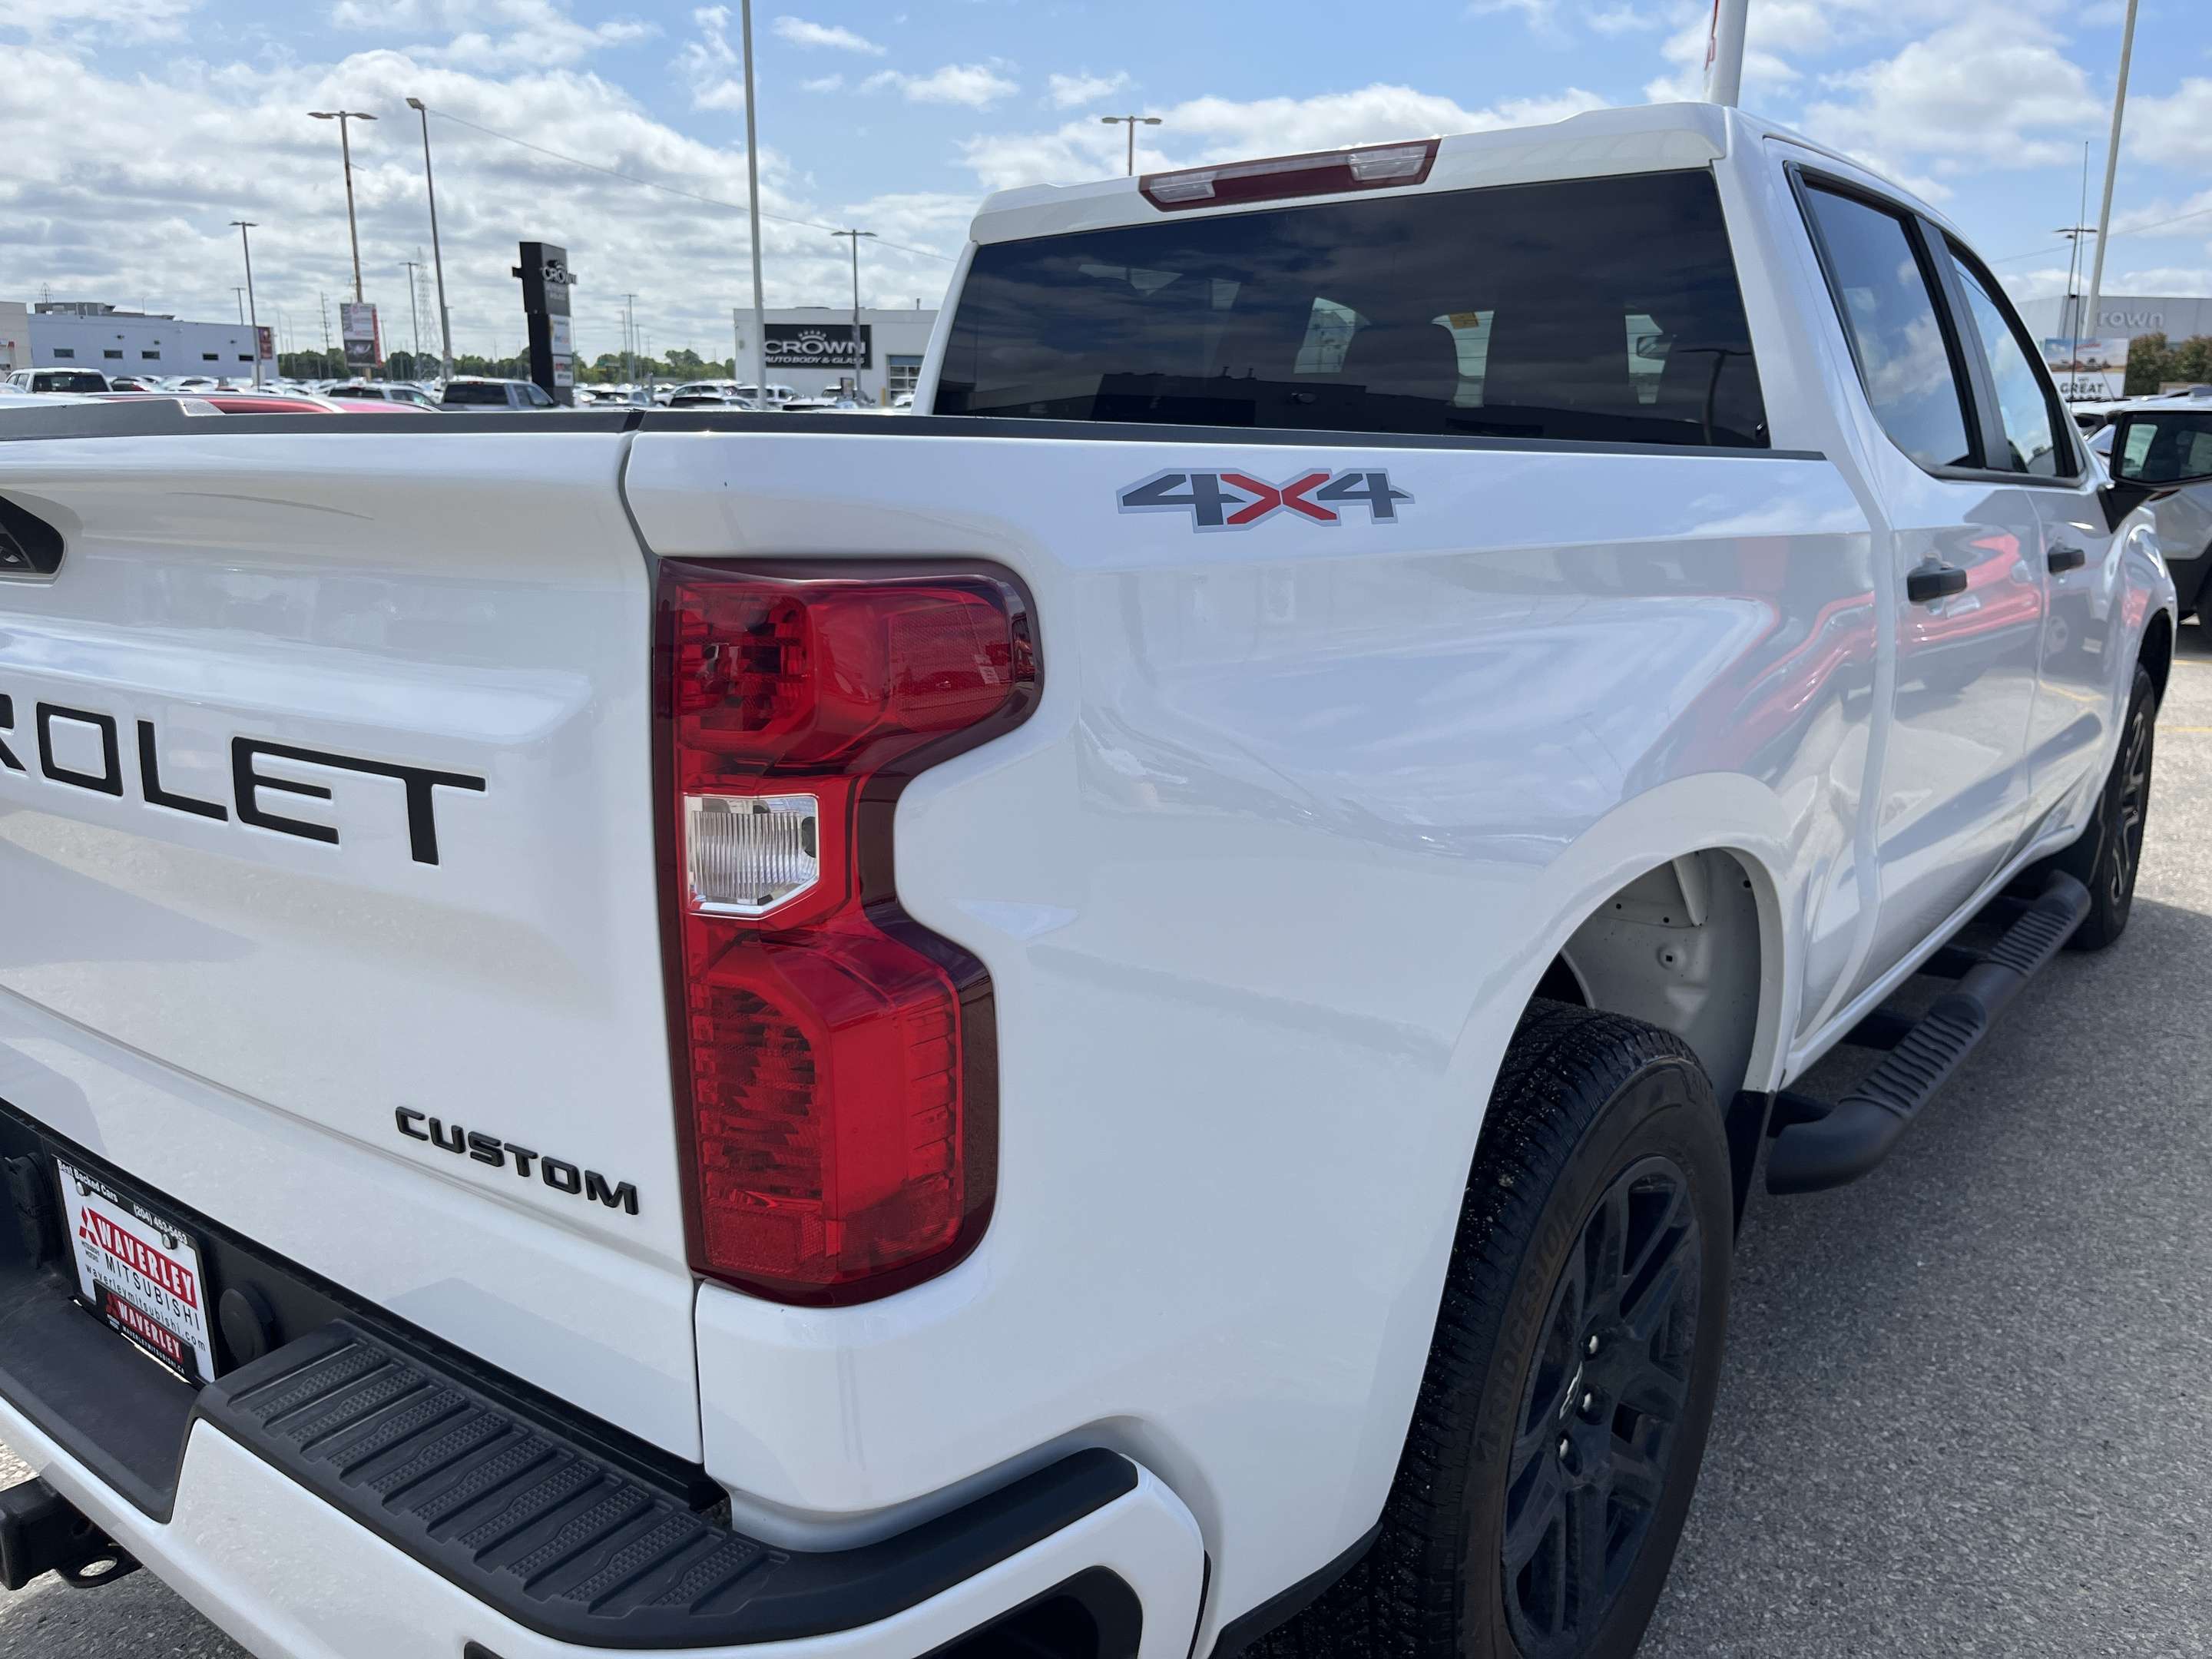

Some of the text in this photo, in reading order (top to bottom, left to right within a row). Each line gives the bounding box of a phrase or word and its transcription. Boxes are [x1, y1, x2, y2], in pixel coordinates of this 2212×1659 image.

[764, 340, 866, 354] CROWN
[2081, 310, 2164, 326] rown
[2060, 382, 2103, 393] GREAT
[394, 1105, 640, 1215] CUSTOM
[57, 1159, 74, 1177] Best
[75, 1170, 100, 1192] Backed
[100, 1184, 118, 1203] Cars
[133, 1204, 153, 1226] (204)
[97, 1217, 194, 1303] WAVERLEY
[105, 1253, 200, 1330] MITSUBISHI
[117, 1300, 181, 1359] WAVERLEY
